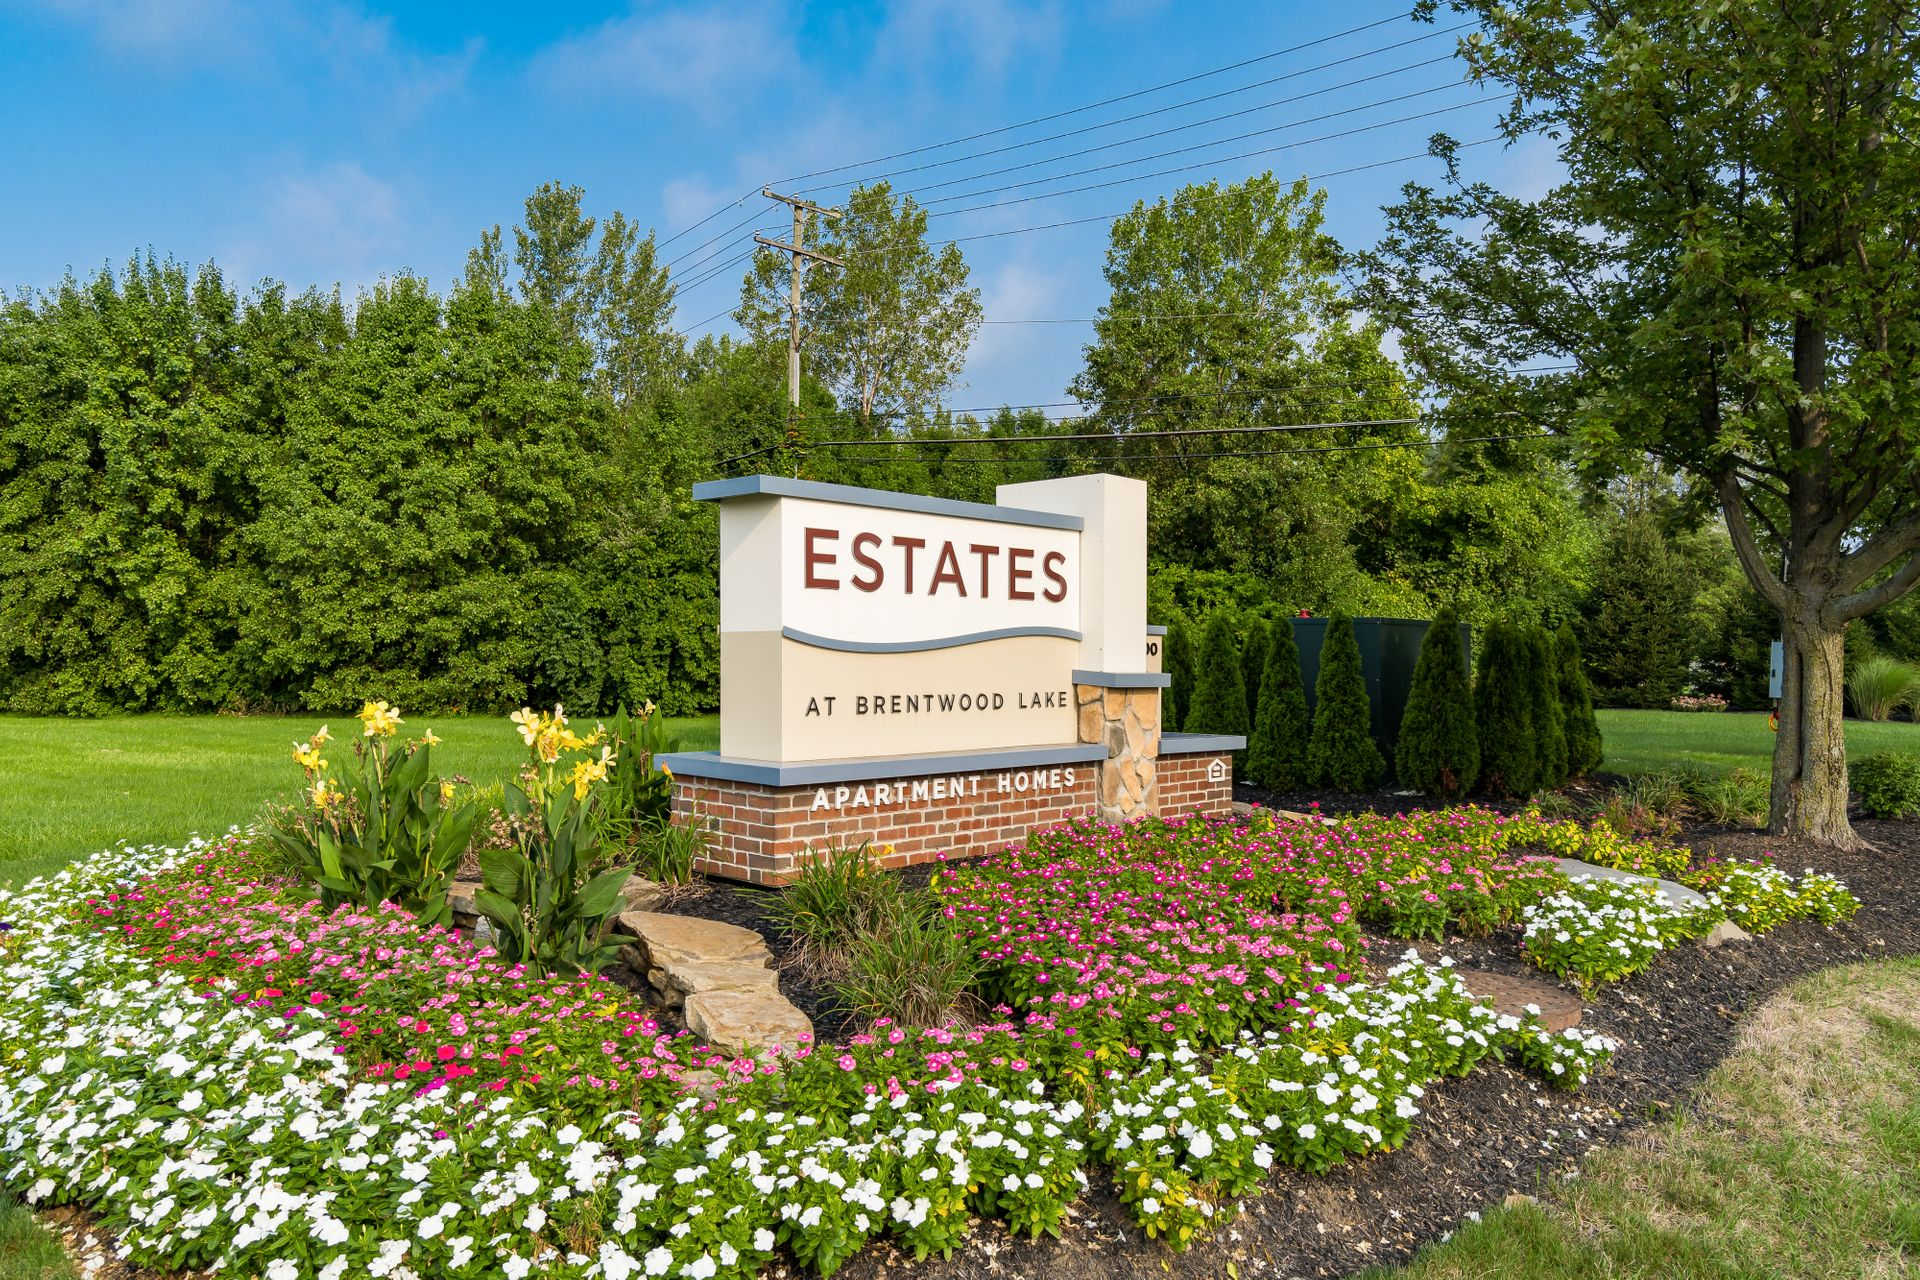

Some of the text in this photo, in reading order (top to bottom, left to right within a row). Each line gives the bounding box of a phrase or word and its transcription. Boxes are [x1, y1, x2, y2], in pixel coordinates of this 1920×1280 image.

[804, 527, 1067, 602] ESTATES
[805, 691, 1067, 716] AT BRENTWOOD LAKE
[810, 768, 1076, 812] APARTMENT HOMES
